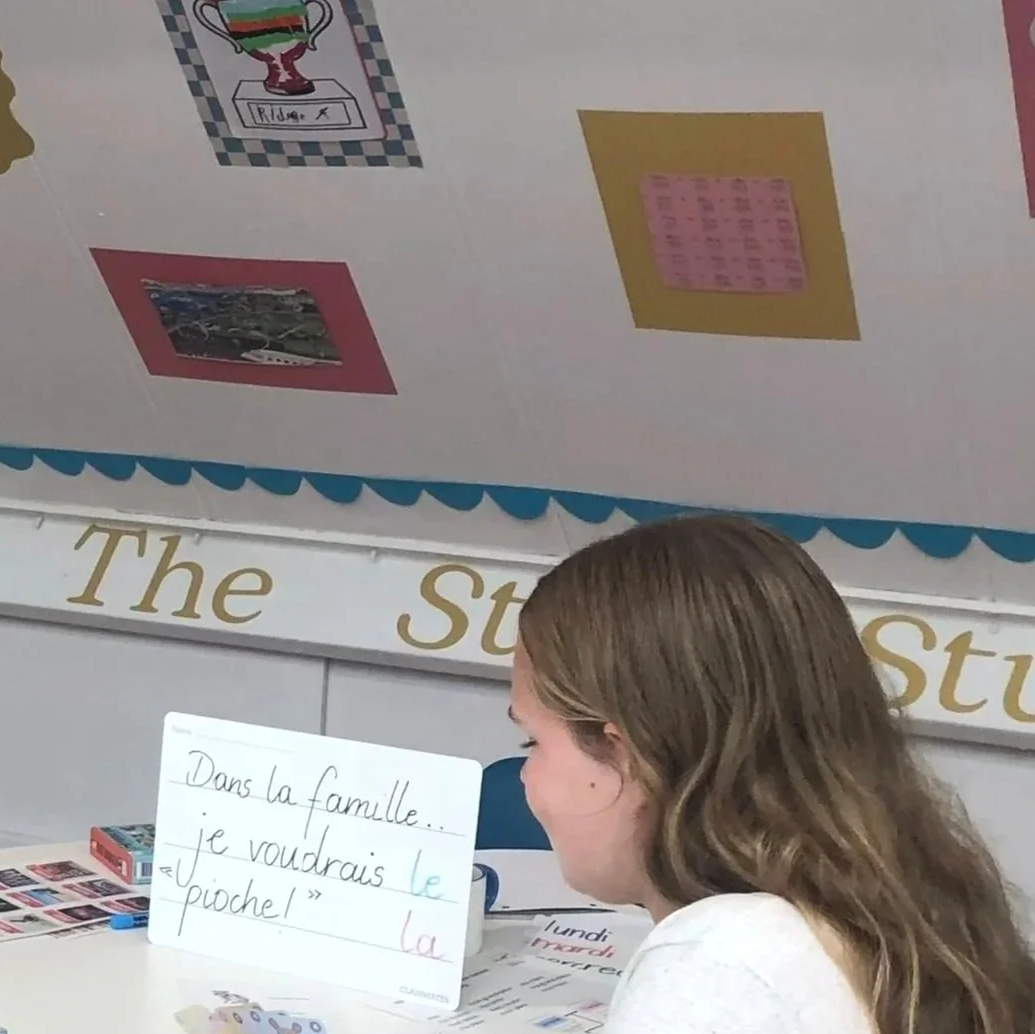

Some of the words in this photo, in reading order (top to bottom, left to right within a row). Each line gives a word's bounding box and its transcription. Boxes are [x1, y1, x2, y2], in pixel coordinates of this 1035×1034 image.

[66, 524, 273, 624] The
[397, 563, 527, 656] St
[185, 750, 252, 800] Dans
[265, 765, 298, 806] la
[175, 811, 229, 888] je
[249, 824, 385, 889] voudrais
[410, 849, 445, 898] le
[400, 909, 447, 961] la
[530, 936, 617, 959] mardi
[544, 919, 613, 943] lundi
